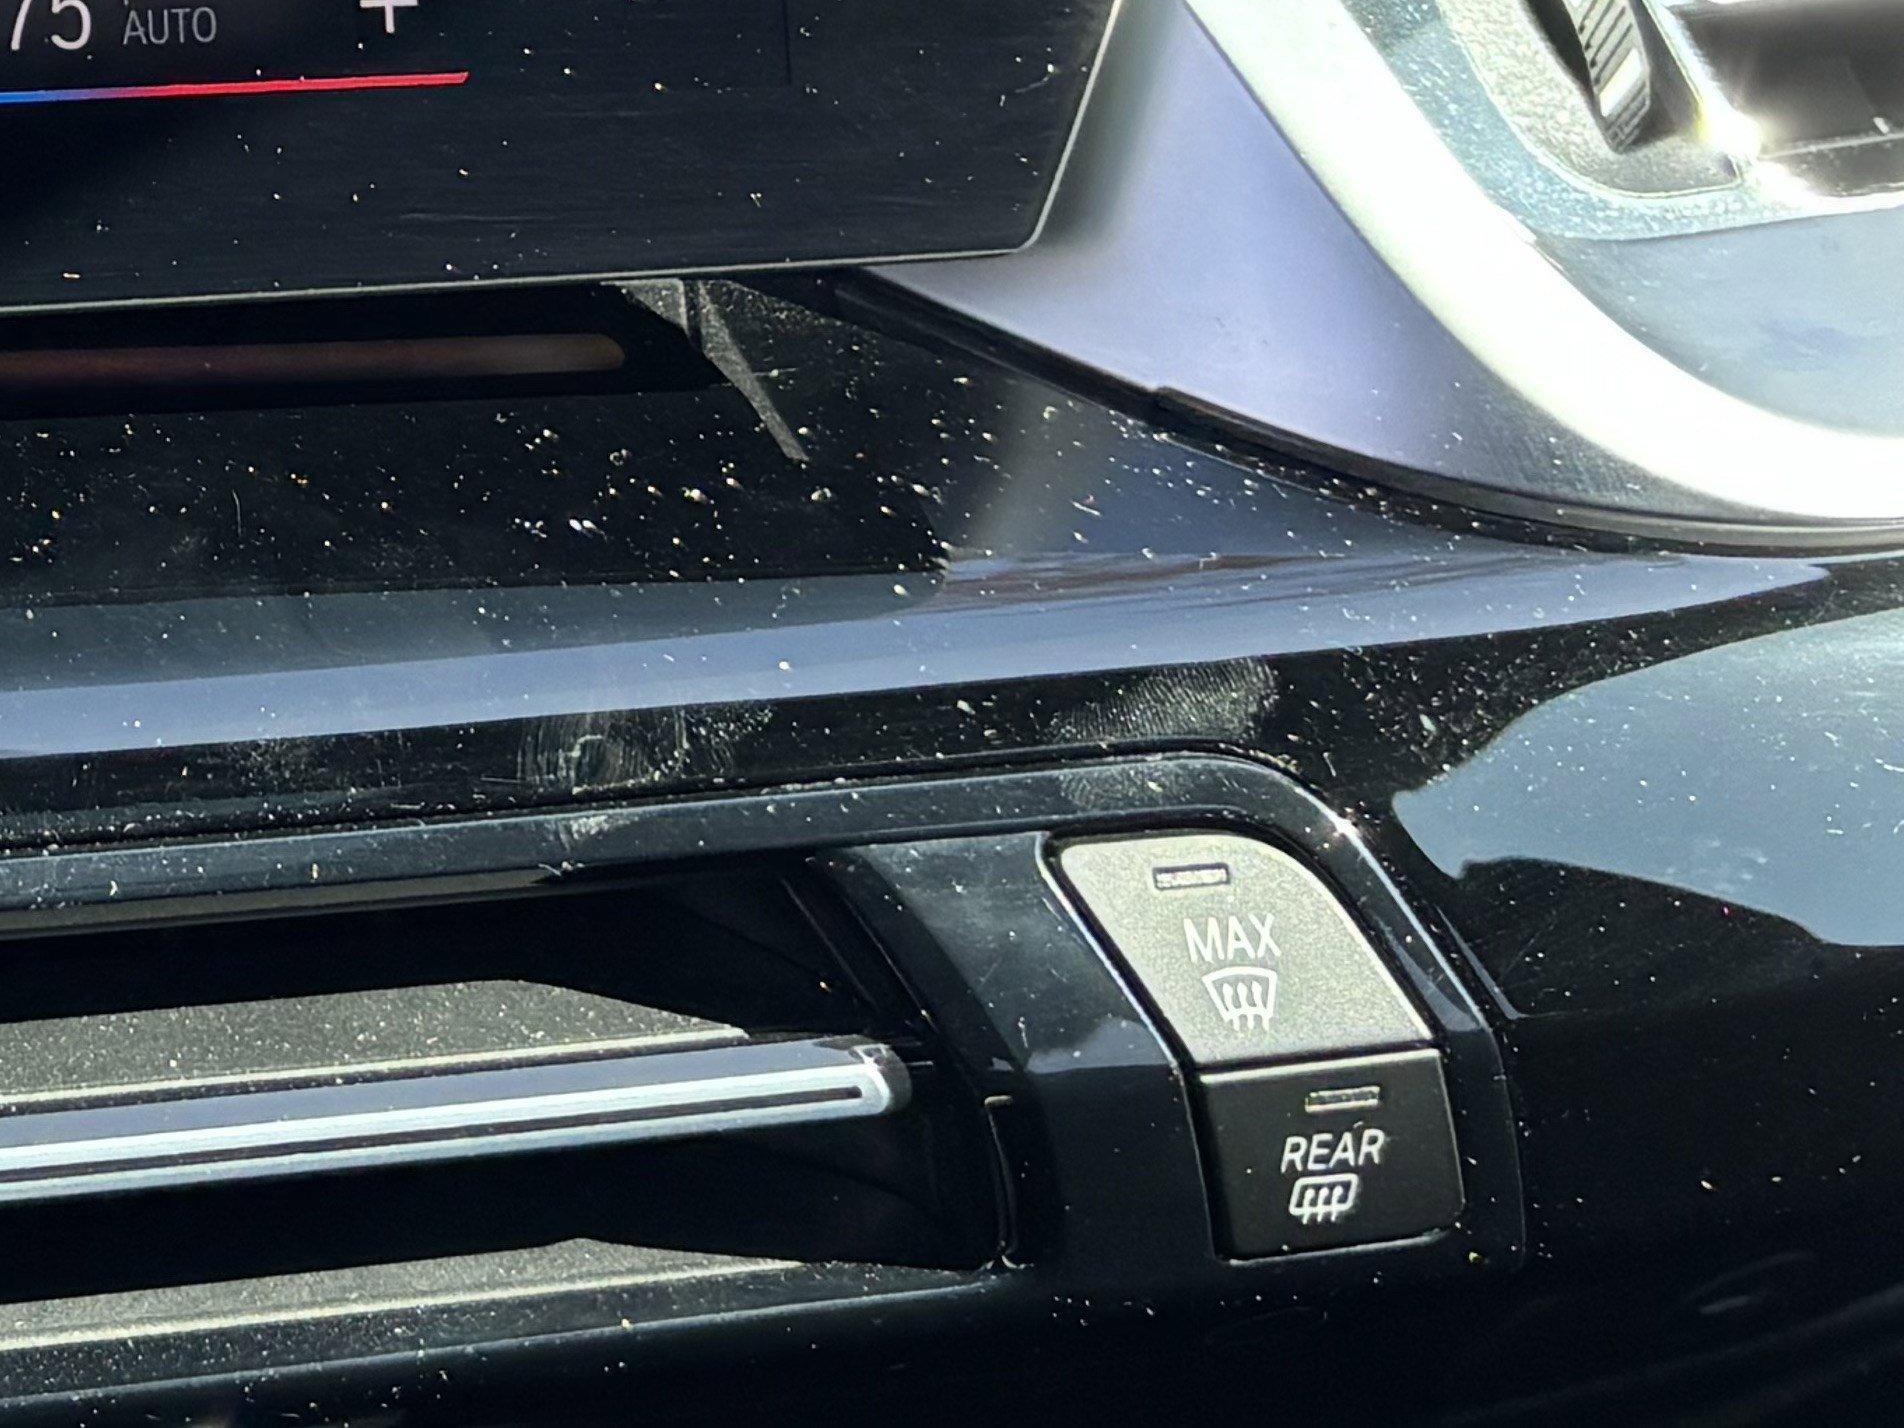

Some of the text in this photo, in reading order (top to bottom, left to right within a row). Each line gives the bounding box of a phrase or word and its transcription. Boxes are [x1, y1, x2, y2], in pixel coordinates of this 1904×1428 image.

[121, 6, 218, 46] AUTO
[1182, 912, 1282, 965] MAX
[1280, 1127, 1387, 1174] REAR
